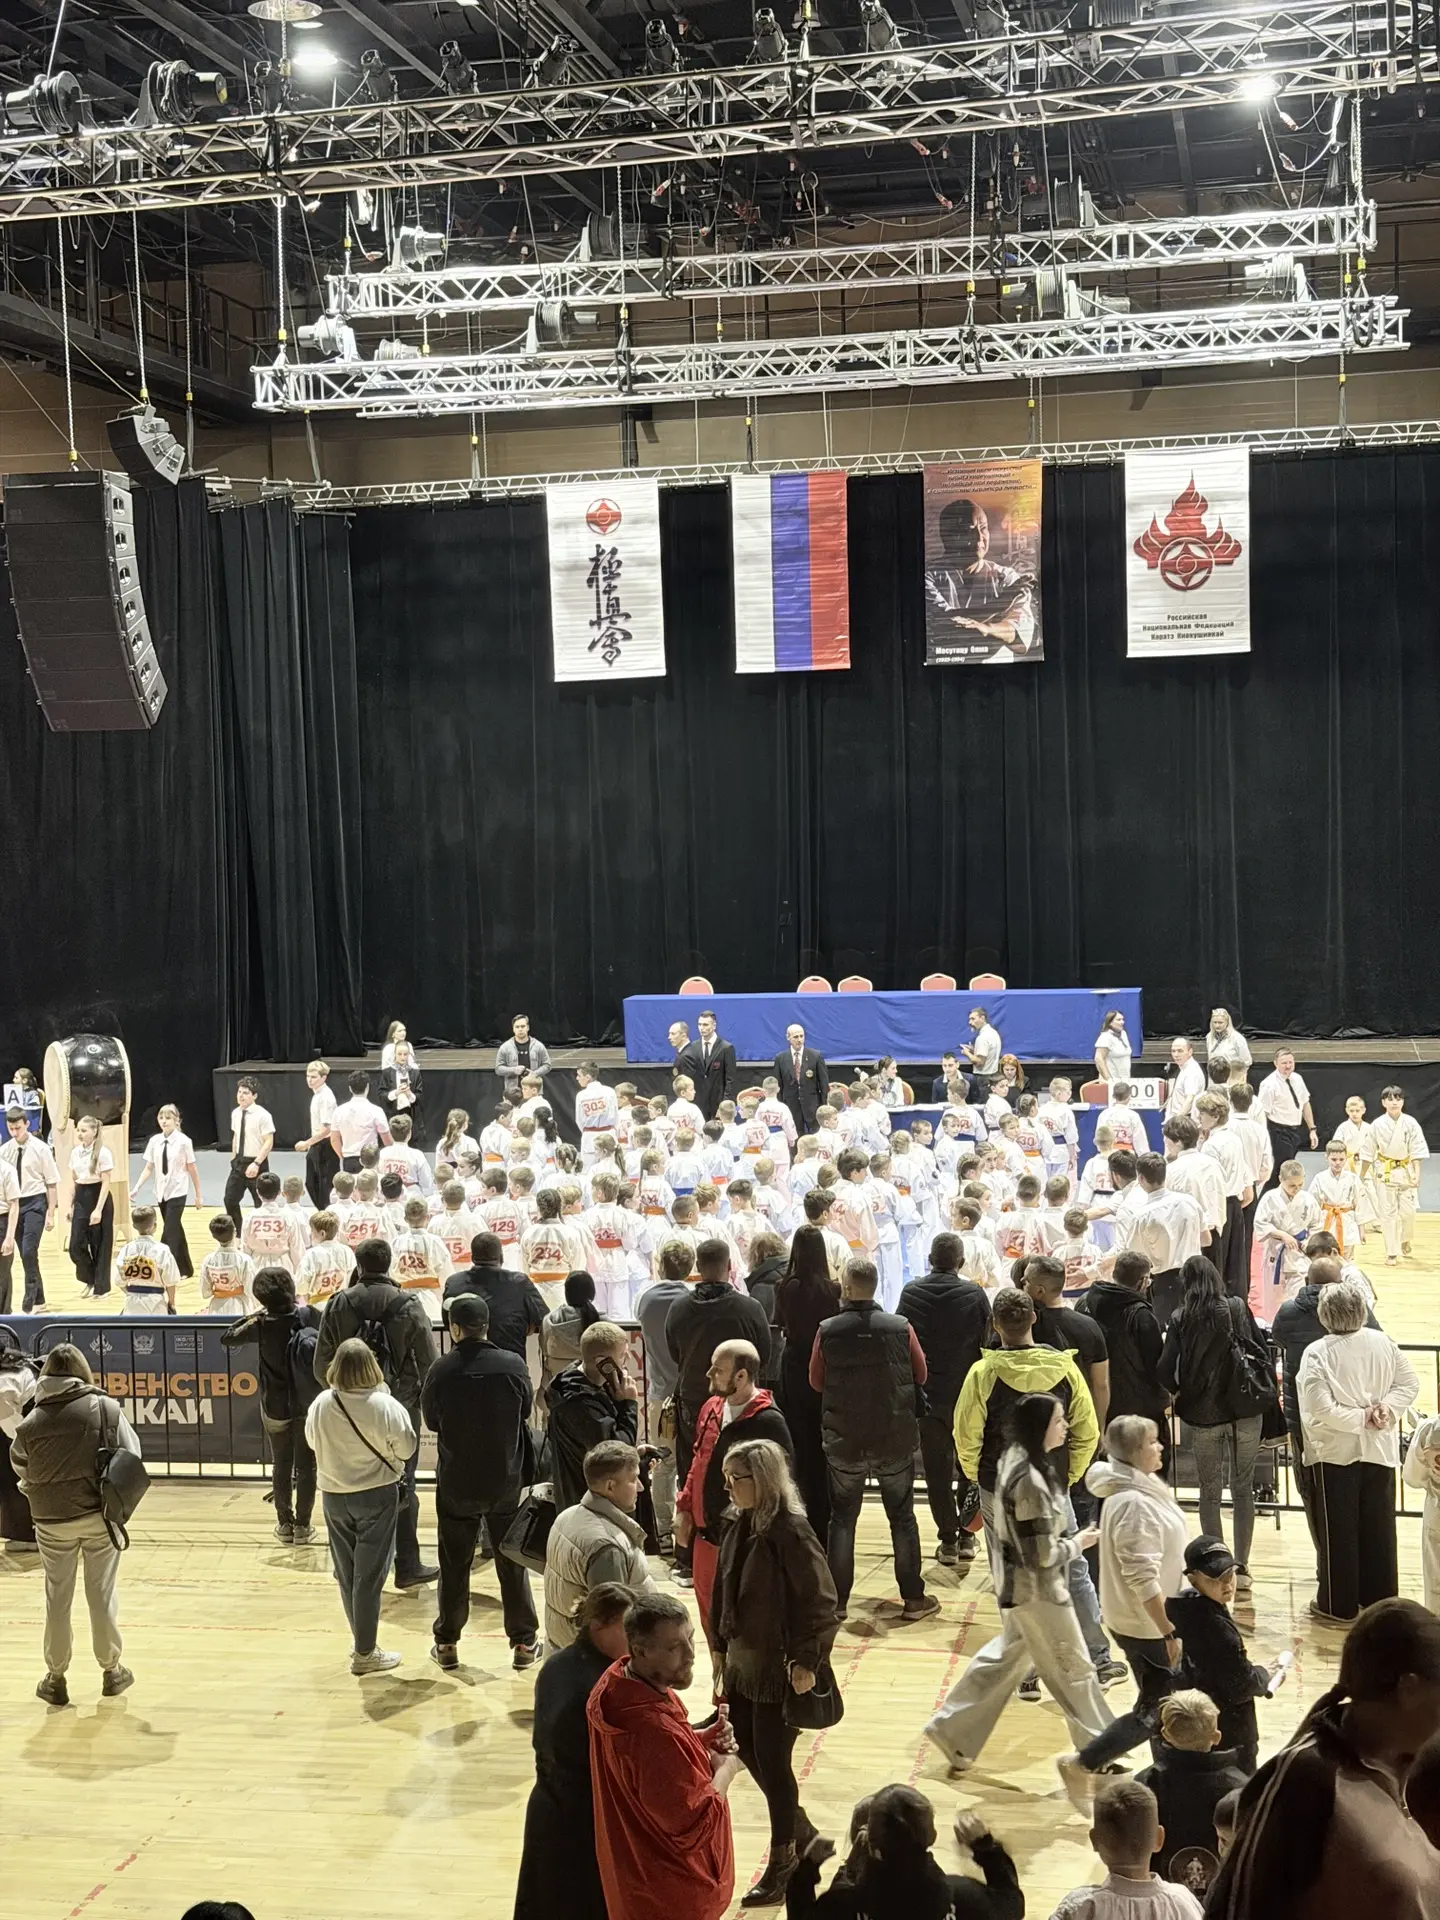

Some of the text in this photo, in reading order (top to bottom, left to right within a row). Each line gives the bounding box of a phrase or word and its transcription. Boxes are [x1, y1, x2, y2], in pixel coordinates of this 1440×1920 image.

[1167, 613, 1207, 621] Российская
[1142, 621, 1234, 631] Национальная Федерация
[253, 1220, 283, 1233] 253
[491, 1220, 516, 1233] 129
